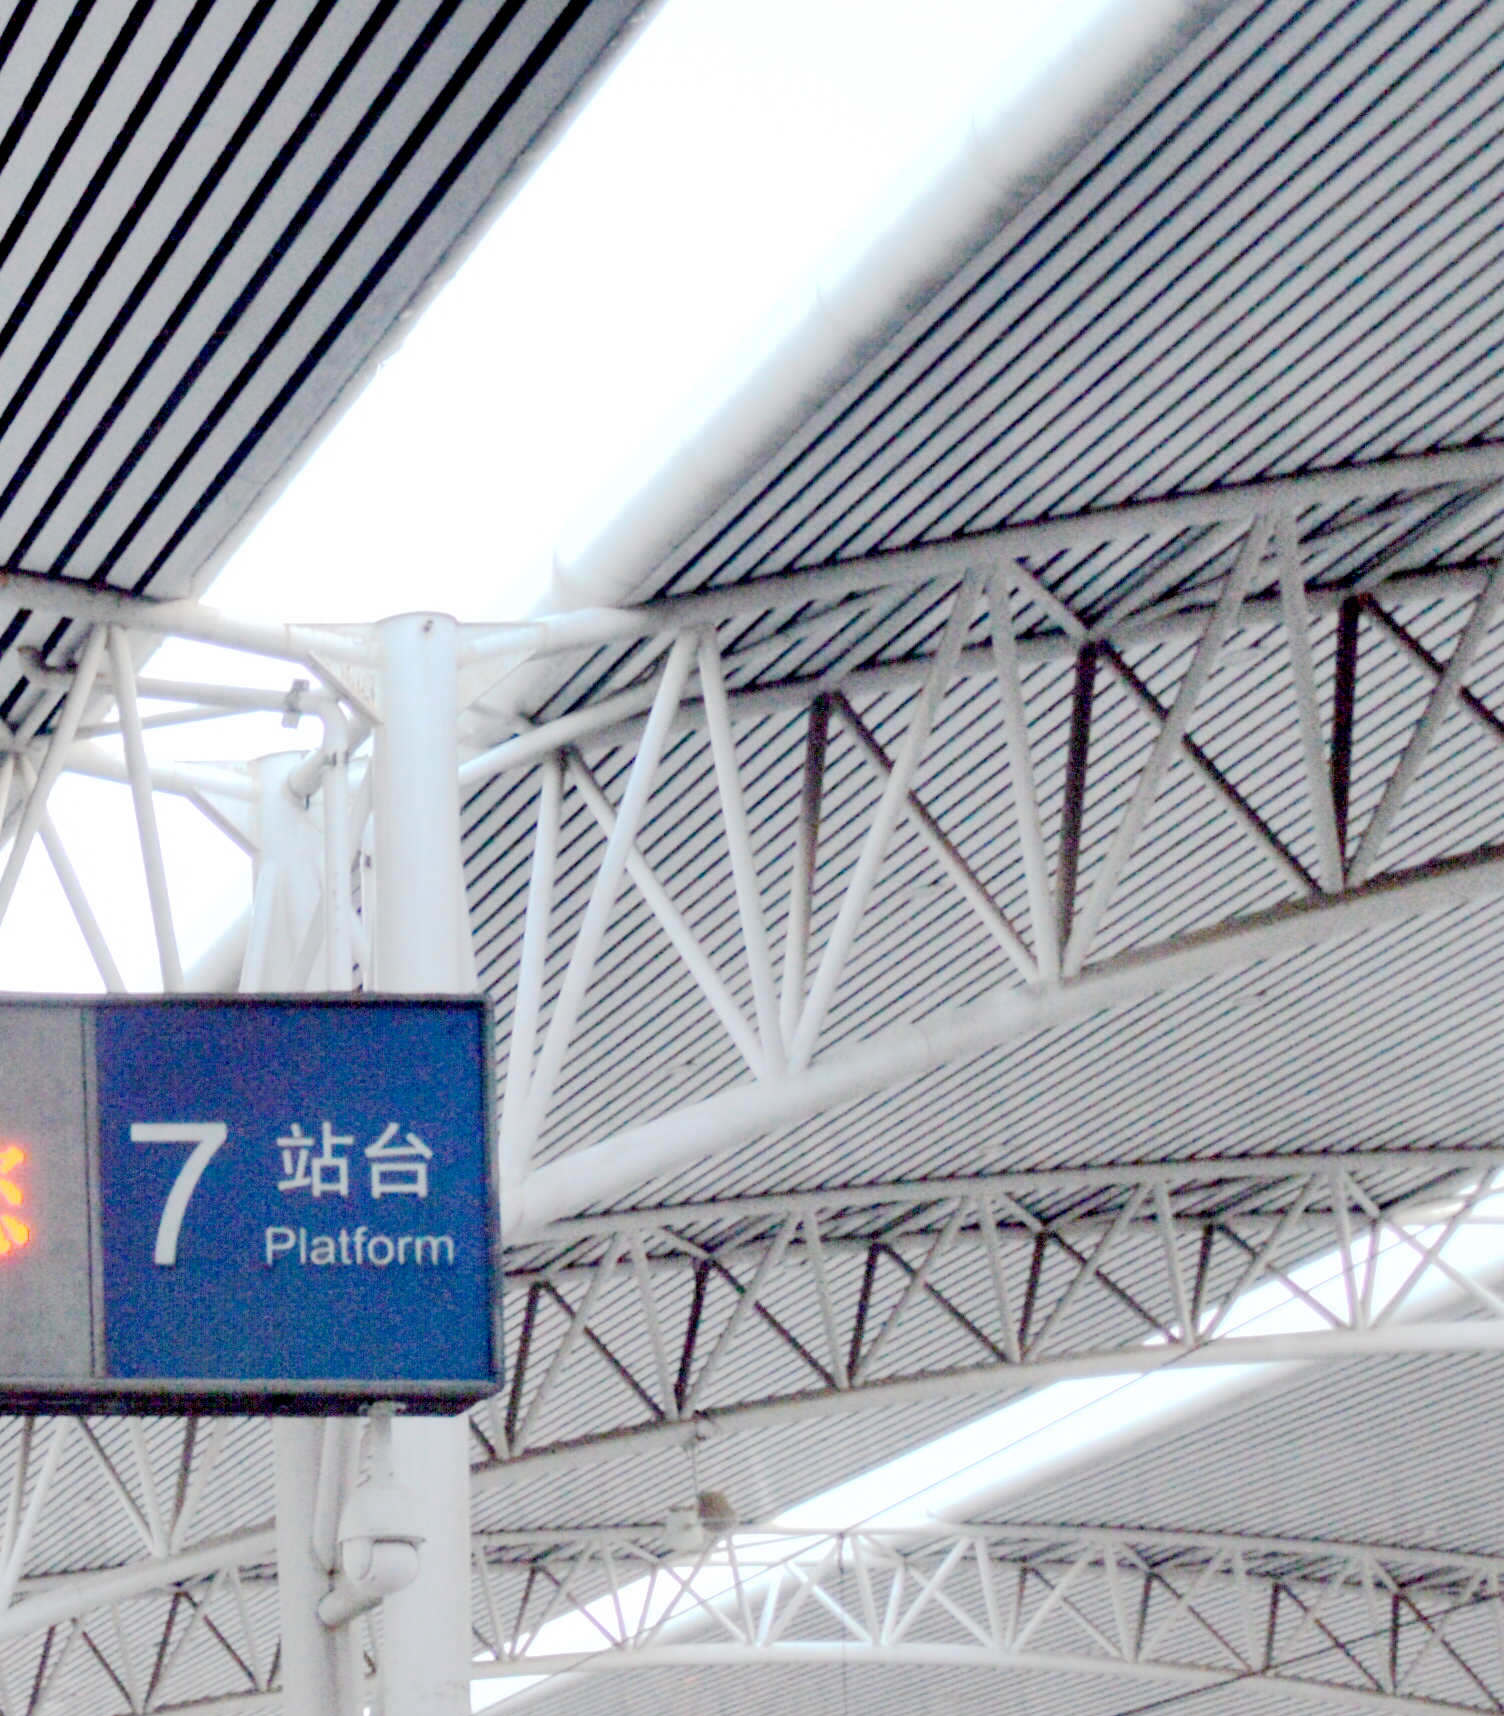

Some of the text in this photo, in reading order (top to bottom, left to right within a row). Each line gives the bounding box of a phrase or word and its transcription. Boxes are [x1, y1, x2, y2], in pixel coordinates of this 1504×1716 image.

[129, 1122, 228, 1266] 7
[276, 1121, 434, 1199] 站台
[264, 1225, 455, 1266] Platform
